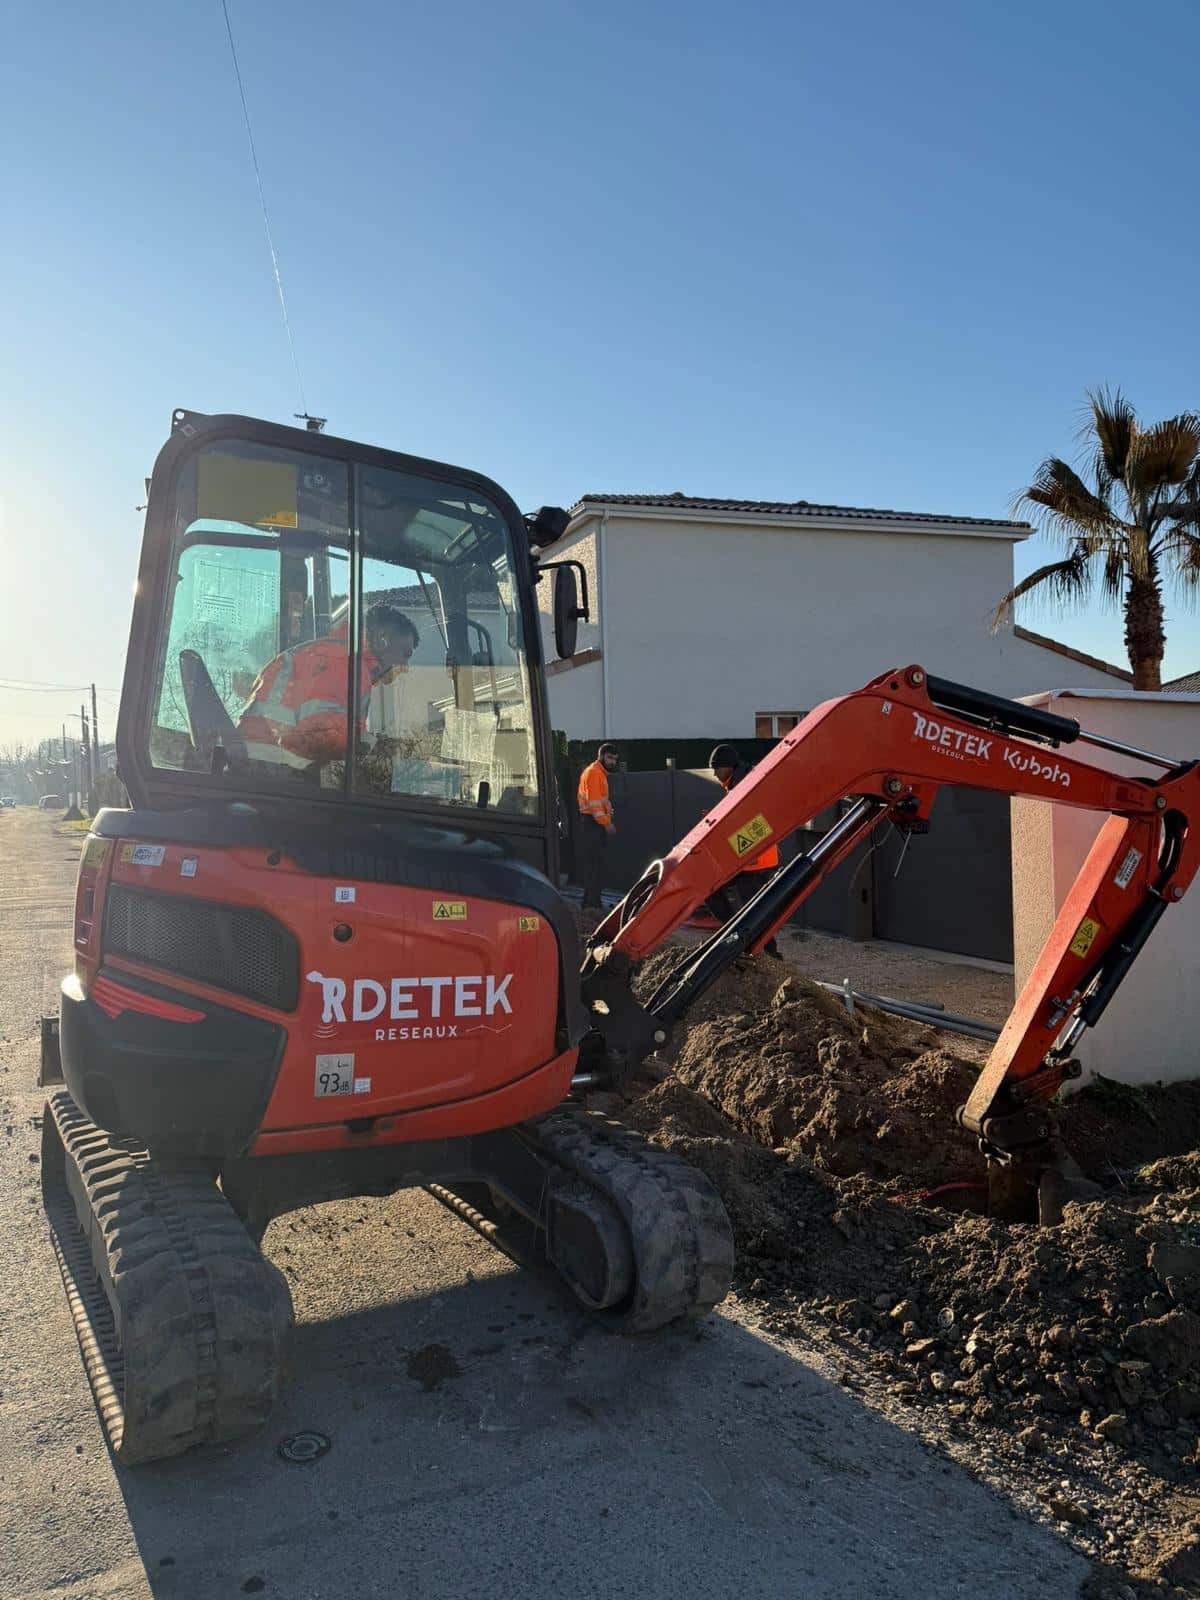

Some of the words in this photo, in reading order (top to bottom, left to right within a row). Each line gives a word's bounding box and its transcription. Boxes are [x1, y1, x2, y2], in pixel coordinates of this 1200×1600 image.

[912, 712, 993, 760] RDETEK
[1003, 747, 1071, 787] Kubota
[306, 970, 514, 1023] RDETEK
[375, 1025, 458, 1041] RESEAUX
